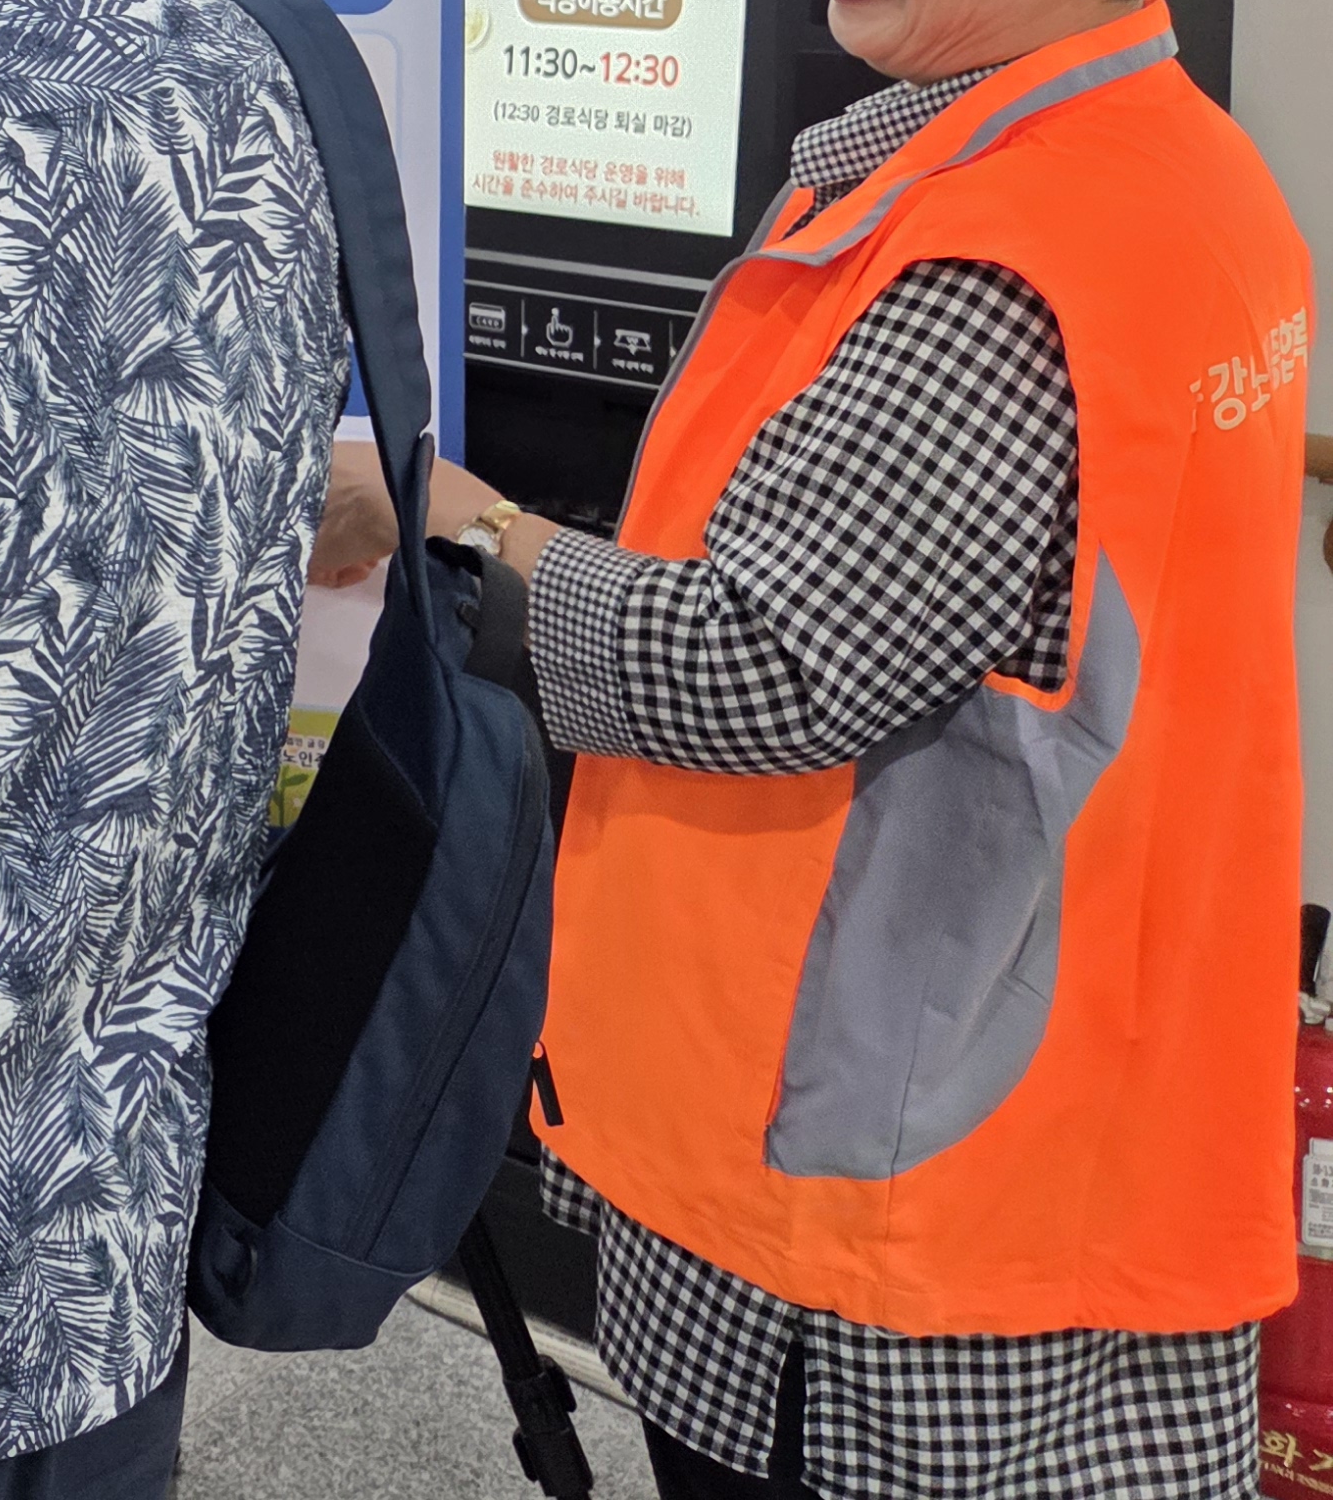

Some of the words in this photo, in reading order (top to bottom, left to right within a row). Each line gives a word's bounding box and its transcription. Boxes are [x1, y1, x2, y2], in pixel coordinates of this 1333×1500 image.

[503, 44, 680, 88] 11:30~12:30
[493, 101, 540, 123] (12:30
[545, 104, 610, 131] 경로식당
[614, 110, 647, 136] 퇴실
[653, 112, 693, 138] 마감)
